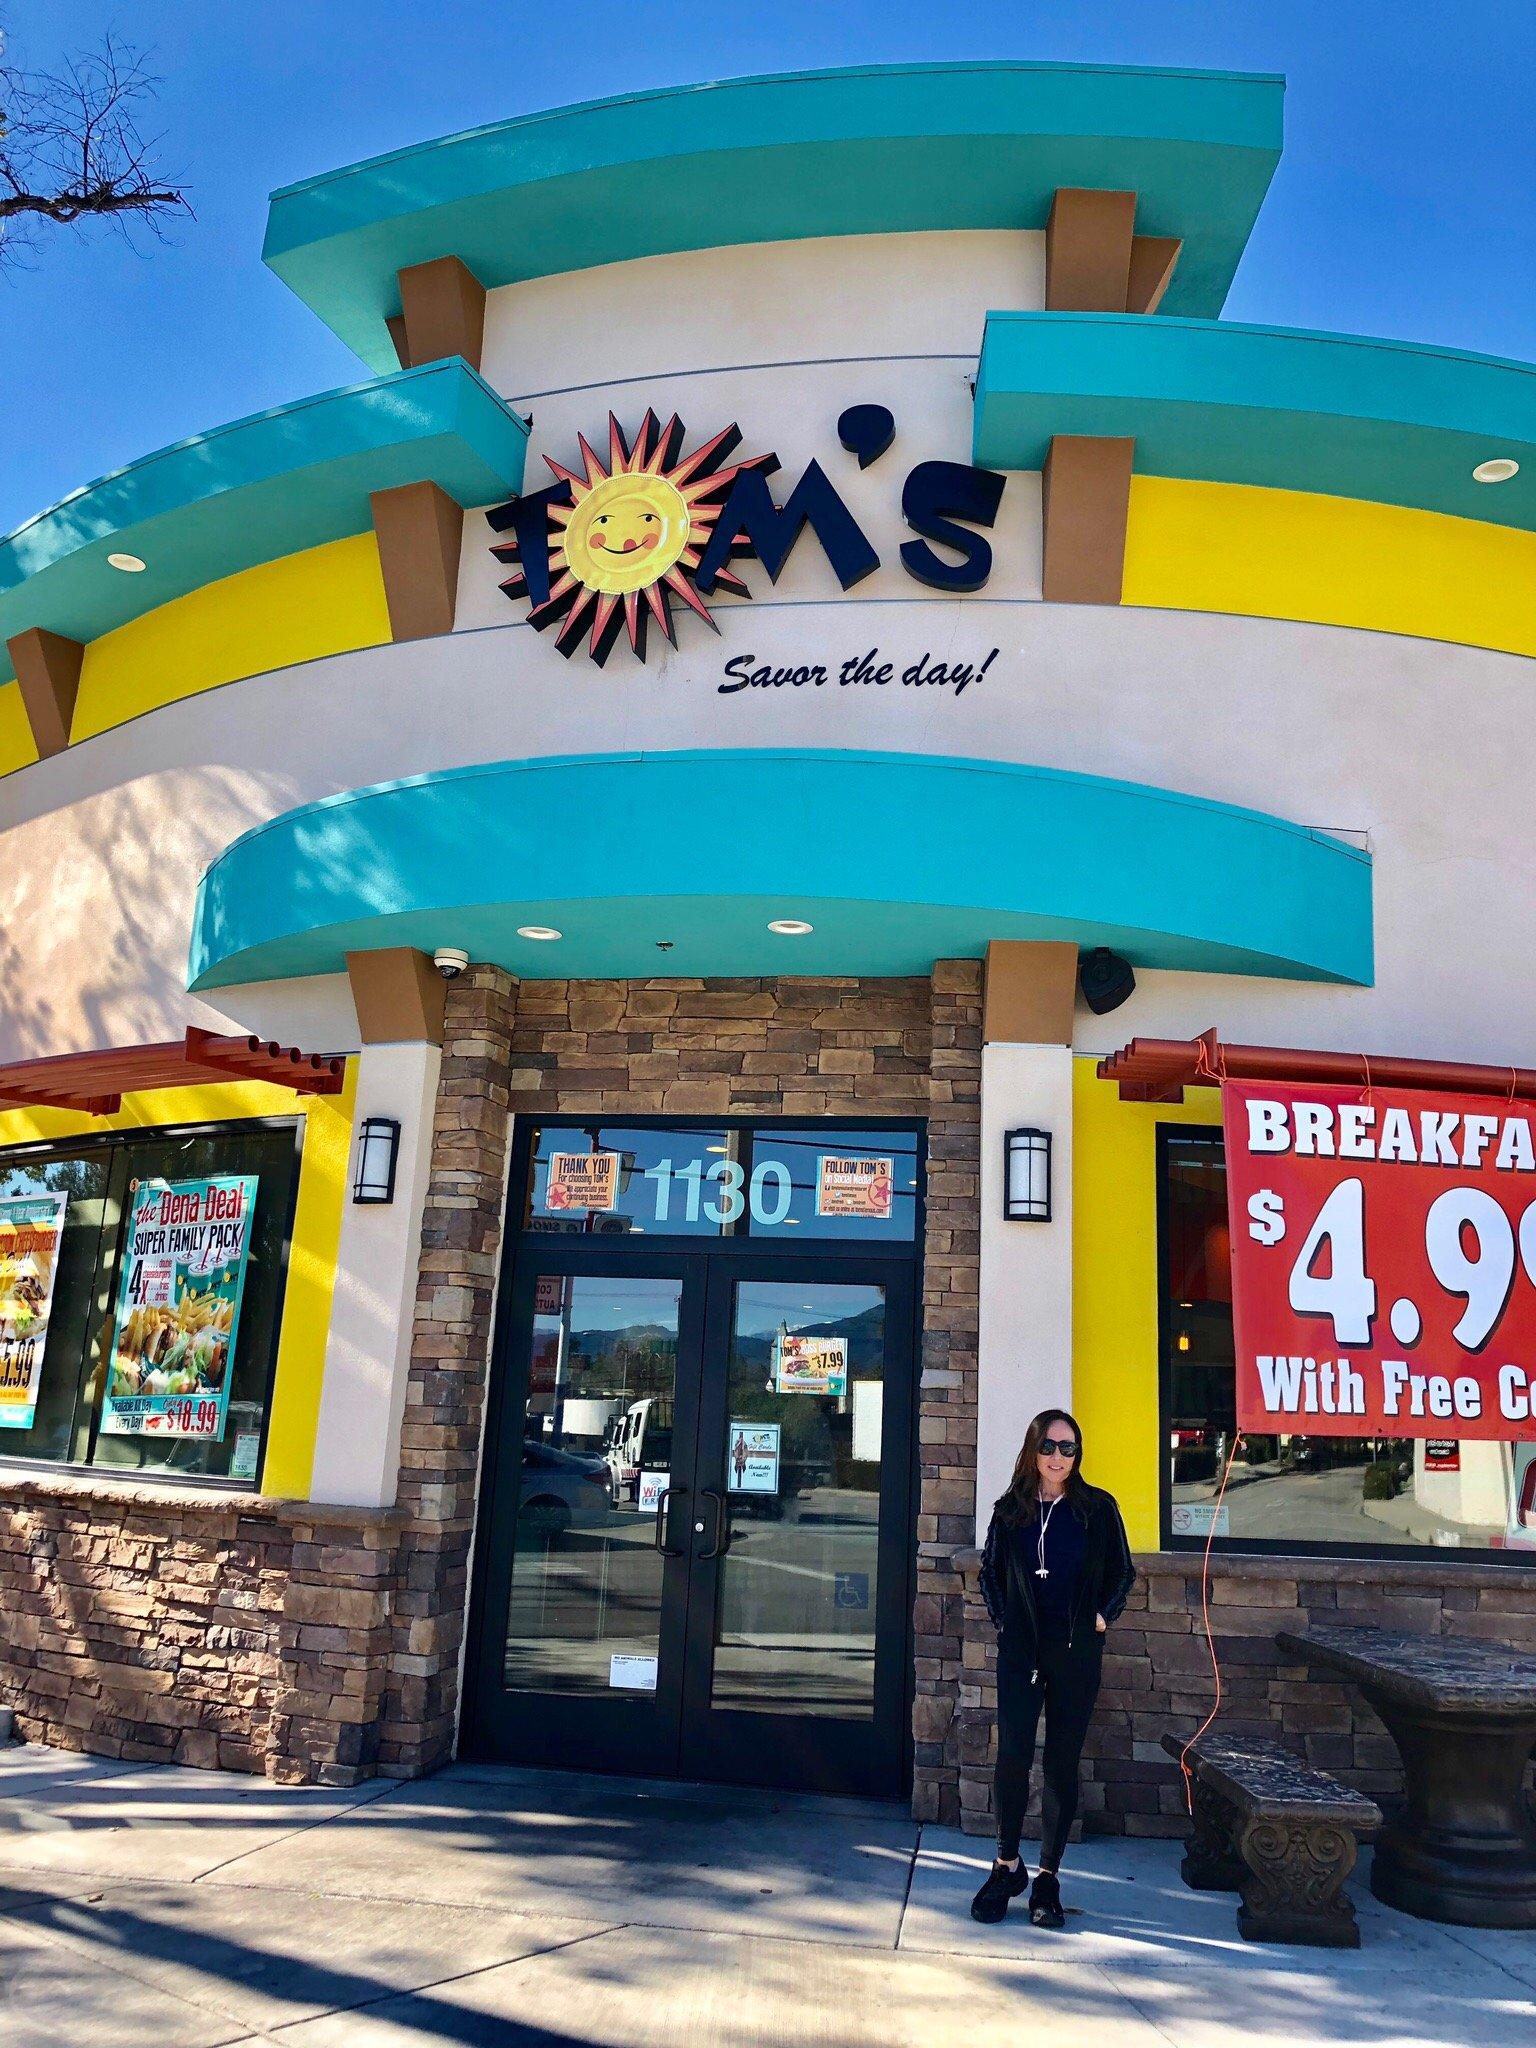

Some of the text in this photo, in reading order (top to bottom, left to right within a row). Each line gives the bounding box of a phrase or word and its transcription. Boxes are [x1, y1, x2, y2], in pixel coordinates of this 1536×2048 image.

[717, 648, 1000, 696] Savor the day!
[1245, 1100, 1536, 1170] BREAKFA
[558, 1158, 610, 1173] THANK YOU
[558, 1174, 567, 1182] For
[568, 1174, 592, 1184] choosing
[825, 1161, 857, 1174] FOLLOW
[136, 1198, 157, 1226] the
[204, 1181, 244, 1221] Deal
[644, 1159, 792, 1225] 1130
[134, 1230, 165, 1255] SUPER
[168, 1225, 206, 1253] FAMILY
[1247, 1177, 1536, 1352] $4.9
[817, 1351, 844, 1368] $7.99
[1256, 1355, 1366, 1416] With
[1382, 1361, 1482, 1419] Free
[166, 1399, 217, 1434] $18.99
